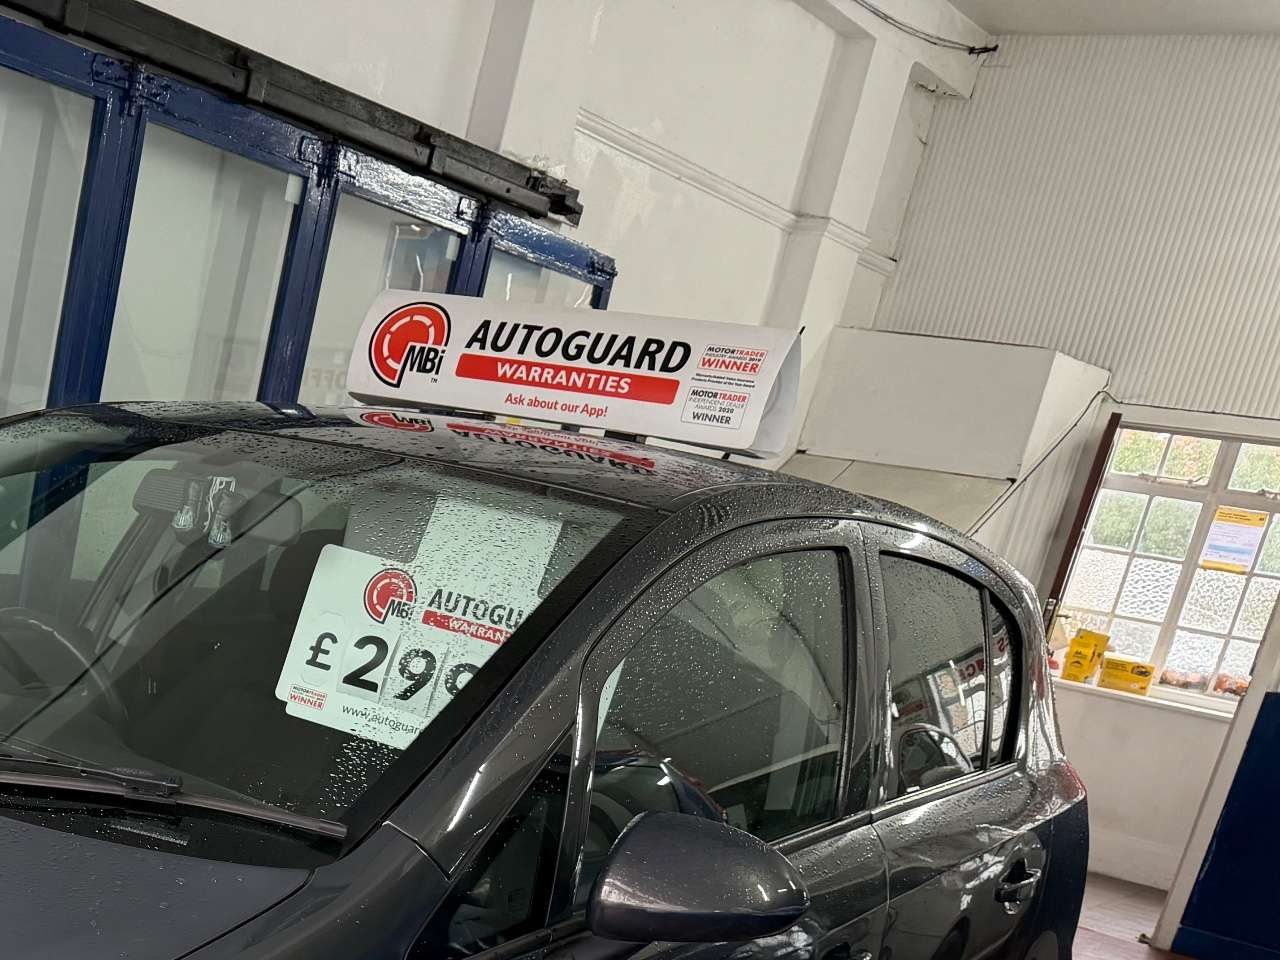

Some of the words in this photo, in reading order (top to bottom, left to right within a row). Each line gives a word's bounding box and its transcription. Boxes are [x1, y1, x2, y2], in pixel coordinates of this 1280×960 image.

[402, 344, 447, 376] MBi
[465, 319, 691, 372] AUTOGUARD
[496, 360, 632, 395] WARRANTIES
[701, 357, 760, 373] WINNER
[504, 392, 524, 407] Ask
[526, 396, 561, 413] about
[563, 402, 581, 415] our
[582, 402, 609, 418] App!
[692, 411, 732, 425] WINNER
[428, 588, 524, 630] AUTOGU
[290, 693, 323, 709] WINNER
[342, 704, 422, 735] www.autoguar
